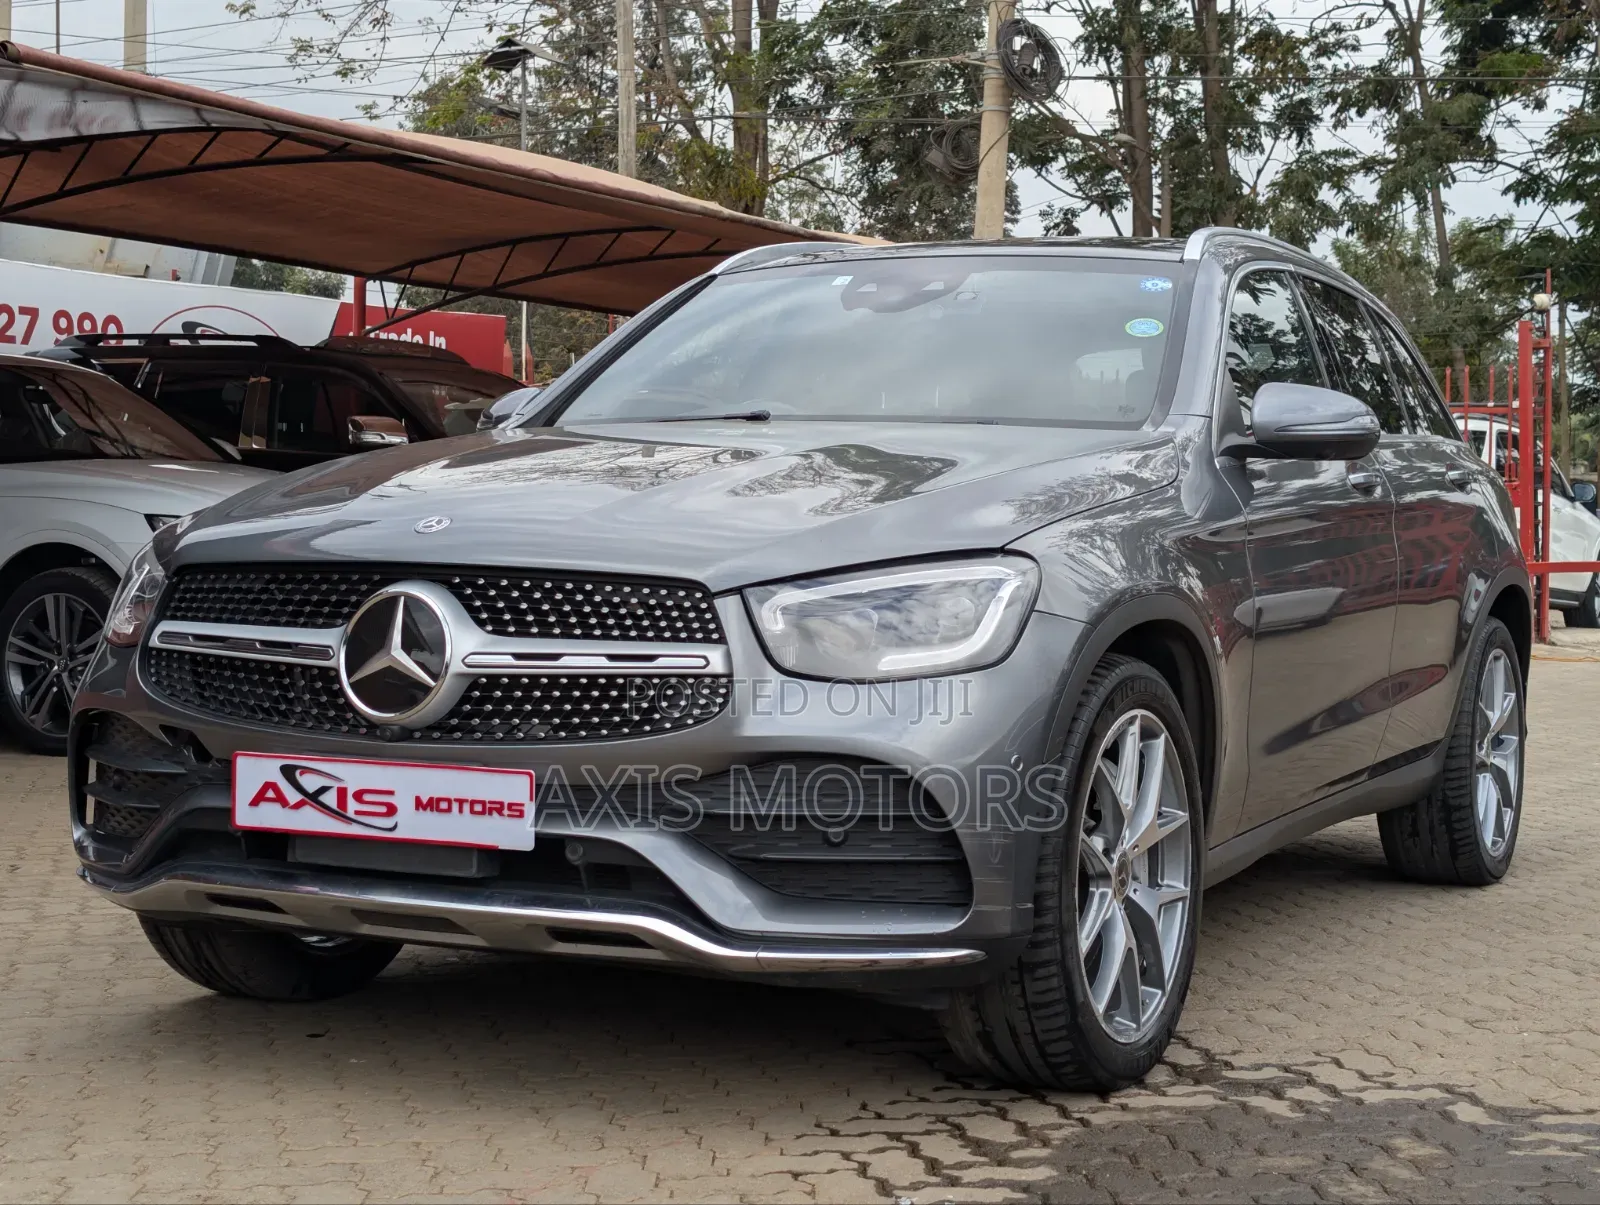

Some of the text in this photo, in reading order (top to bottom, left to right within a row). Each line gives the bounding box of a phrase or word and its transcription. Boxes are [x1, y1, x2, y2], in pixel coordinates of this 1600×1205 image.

[0, 303, 124, 346] 27 990
[429, 330, 447, 351] In
[248, 774, 526, 826] AXIS MOTORS
